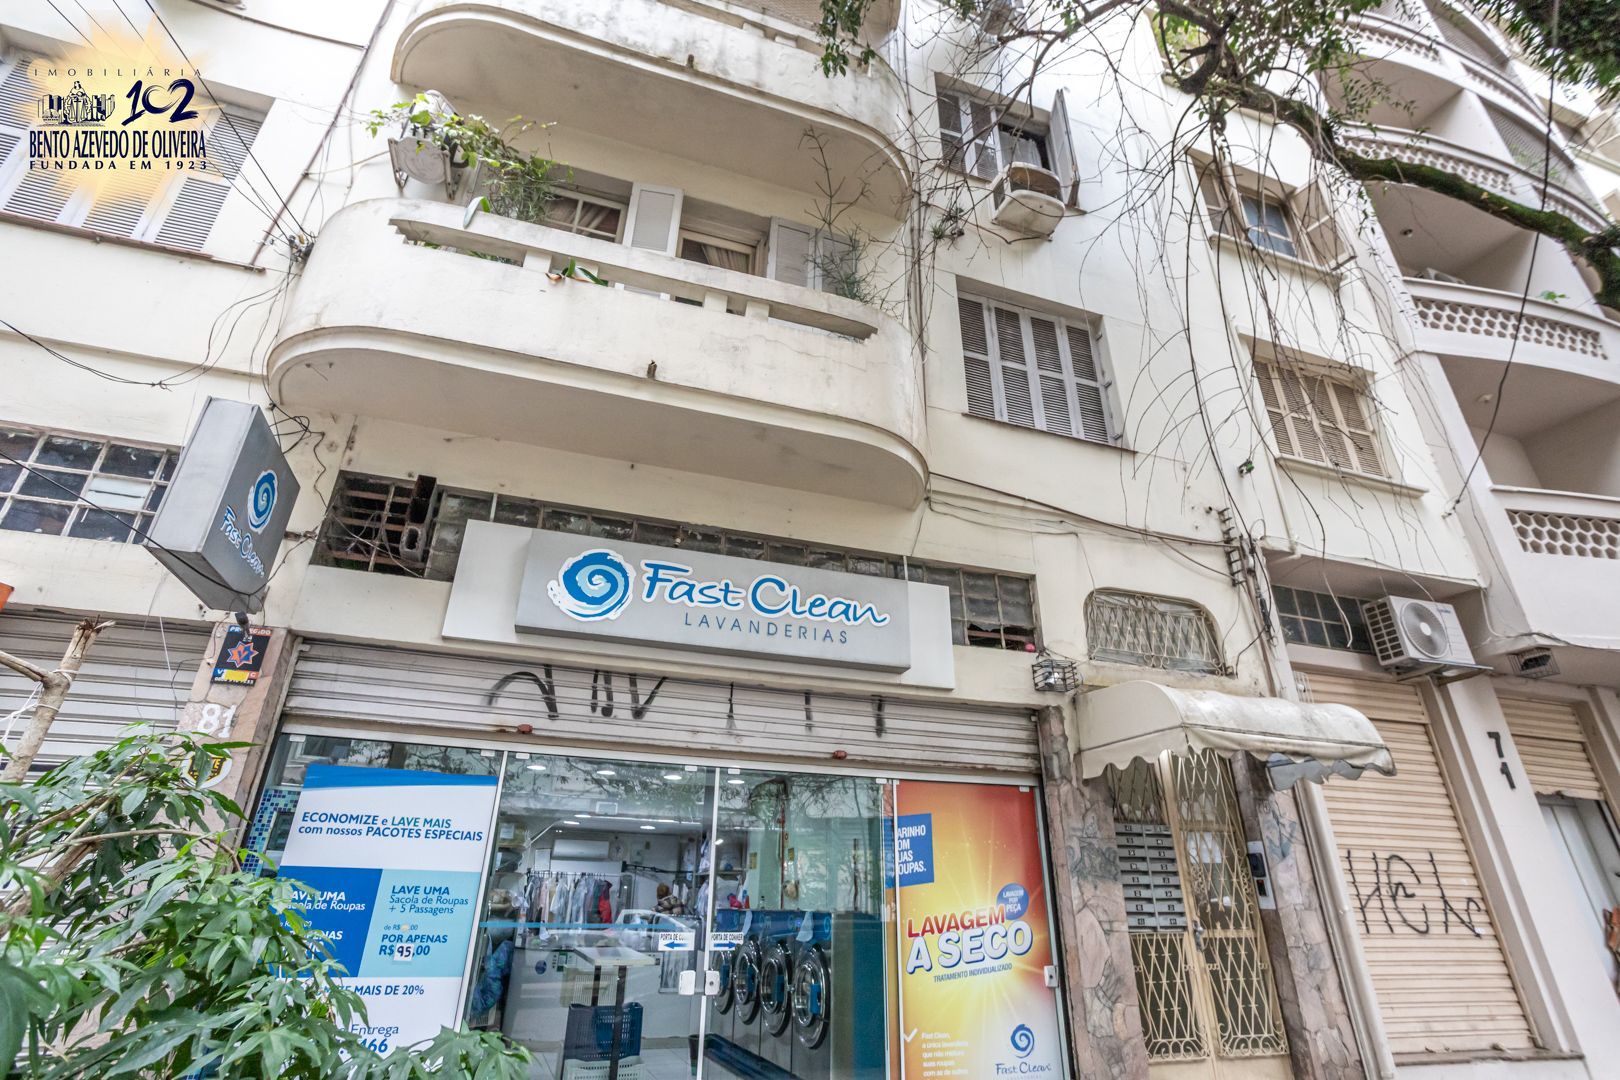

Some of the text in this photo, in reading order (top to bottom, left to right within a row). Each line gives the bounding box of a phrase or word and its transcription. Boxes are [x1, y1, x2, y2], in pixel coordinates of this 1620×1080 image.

[642, 561, 888, 625] Fast Clean
[684, 611, 849, 645] LAVANDERIAS
[199, 703, 237, 738] 81
[302, 811, 452, 829] ECONOMIZE e LAVE MAIS
[298, 826, 484, 841] com nossos PACOTES ESPECIAIS
[897, 824, 926, 838] ARINHO
[897, 839, 910, 851] OM
[897, 850, 914, 863] UAS
[898, 860, 927, 875] OUPAS.
[392, 885, 450, 895] LAVE UMA
[314, 901, 328, 910] de
[330, 900, 366, 912] Roupas
[389, 895, 469, 907] Sacola de Roupas
[400, 904, 406, 913] 5
[409, 904, 454, 916] Passagens
[907, 904, 1006, 939] LAVAGEM
[382, 934, 448, 943] POR APENAS
[906, 920, 1034, 975] A SECO
[934, 970, 969, 983] TRATAMENTO
[354, 985, 382, 995] MAIS
[385, 985, 400, 995] DE
[402, 984, 425, 995] 20%
[351, 1023, 399, 1037] Entrega
[995, 1062, 1018, 1076] Fast
